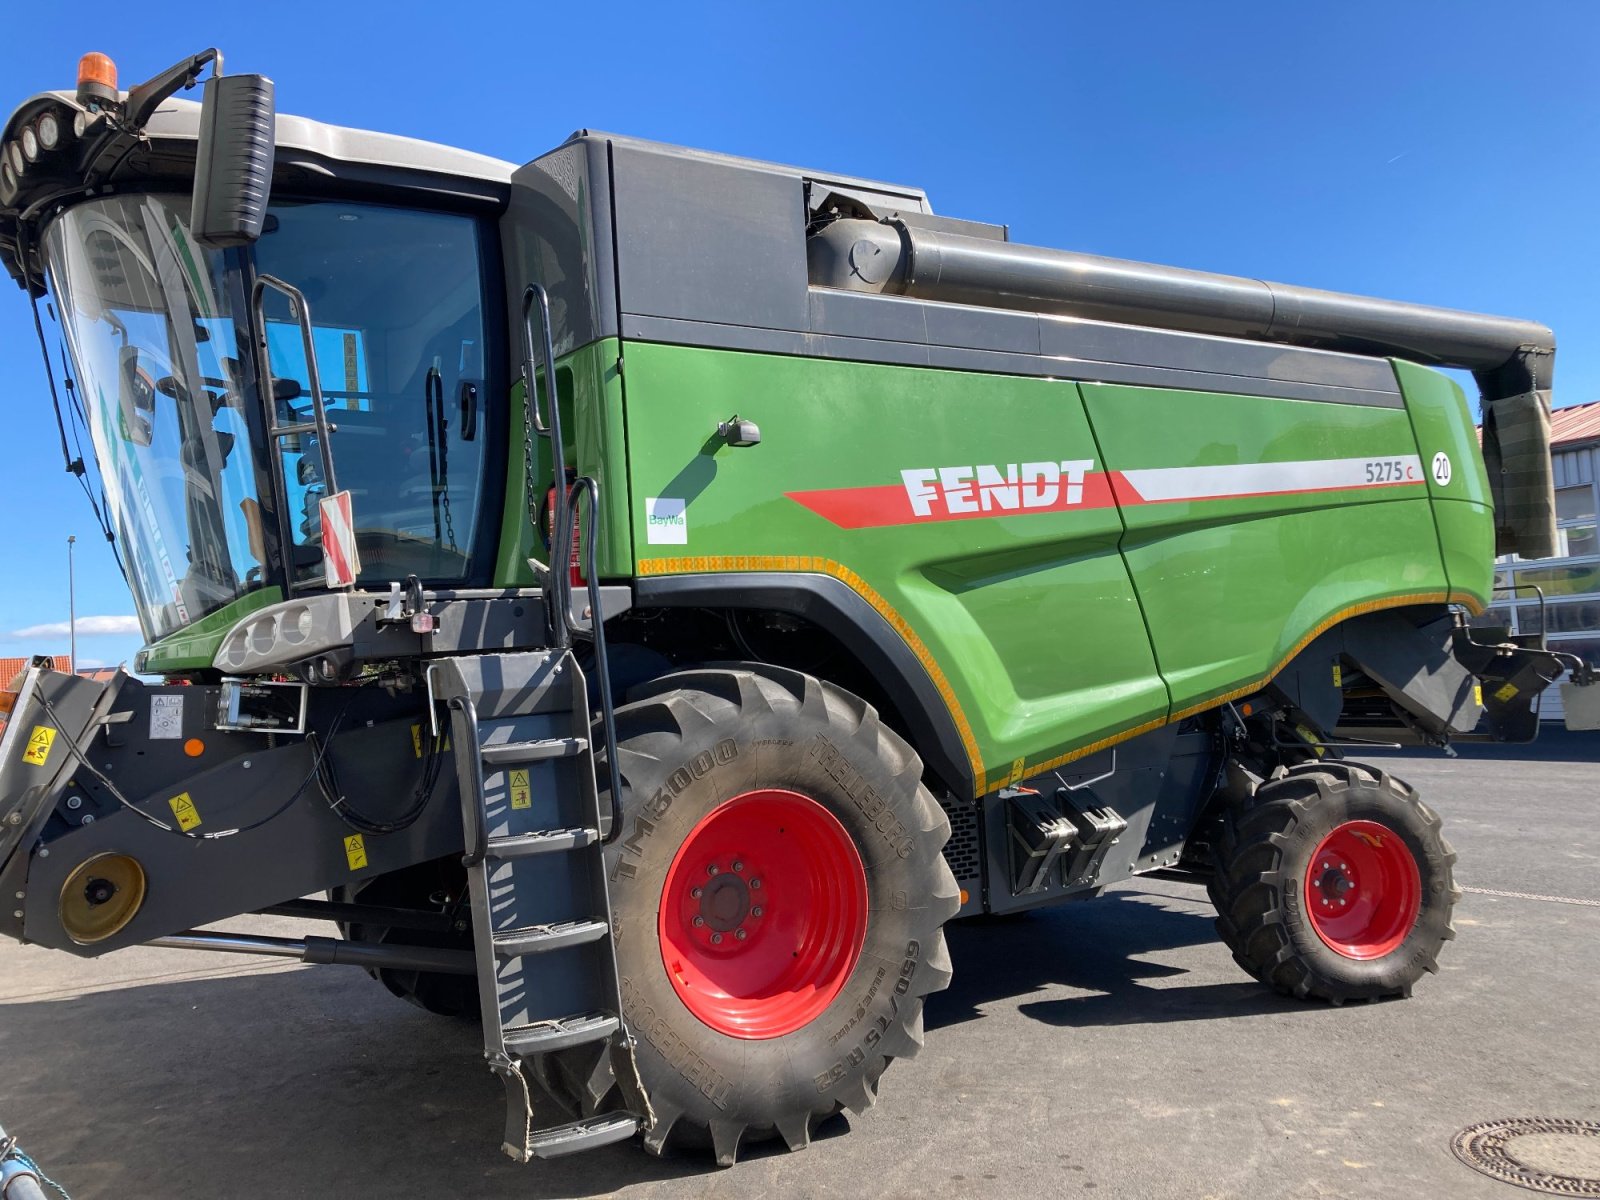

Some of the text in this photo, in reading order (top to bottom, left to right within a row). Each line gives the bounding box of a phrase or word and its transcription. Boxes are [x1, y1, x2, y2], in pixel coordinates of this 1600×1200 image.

[900, 459, 1095, 517] FENDT
[1365, 461, 1403, 483] 5275
[1435, 457, 1449, 480] 20
[648, 514, 684, 527] BayWa
[610, 738, 738, 882] TM3000
[810, 732, 916, 860] TRELLEBORG
[863, 938, 920, 1051] 650/75
